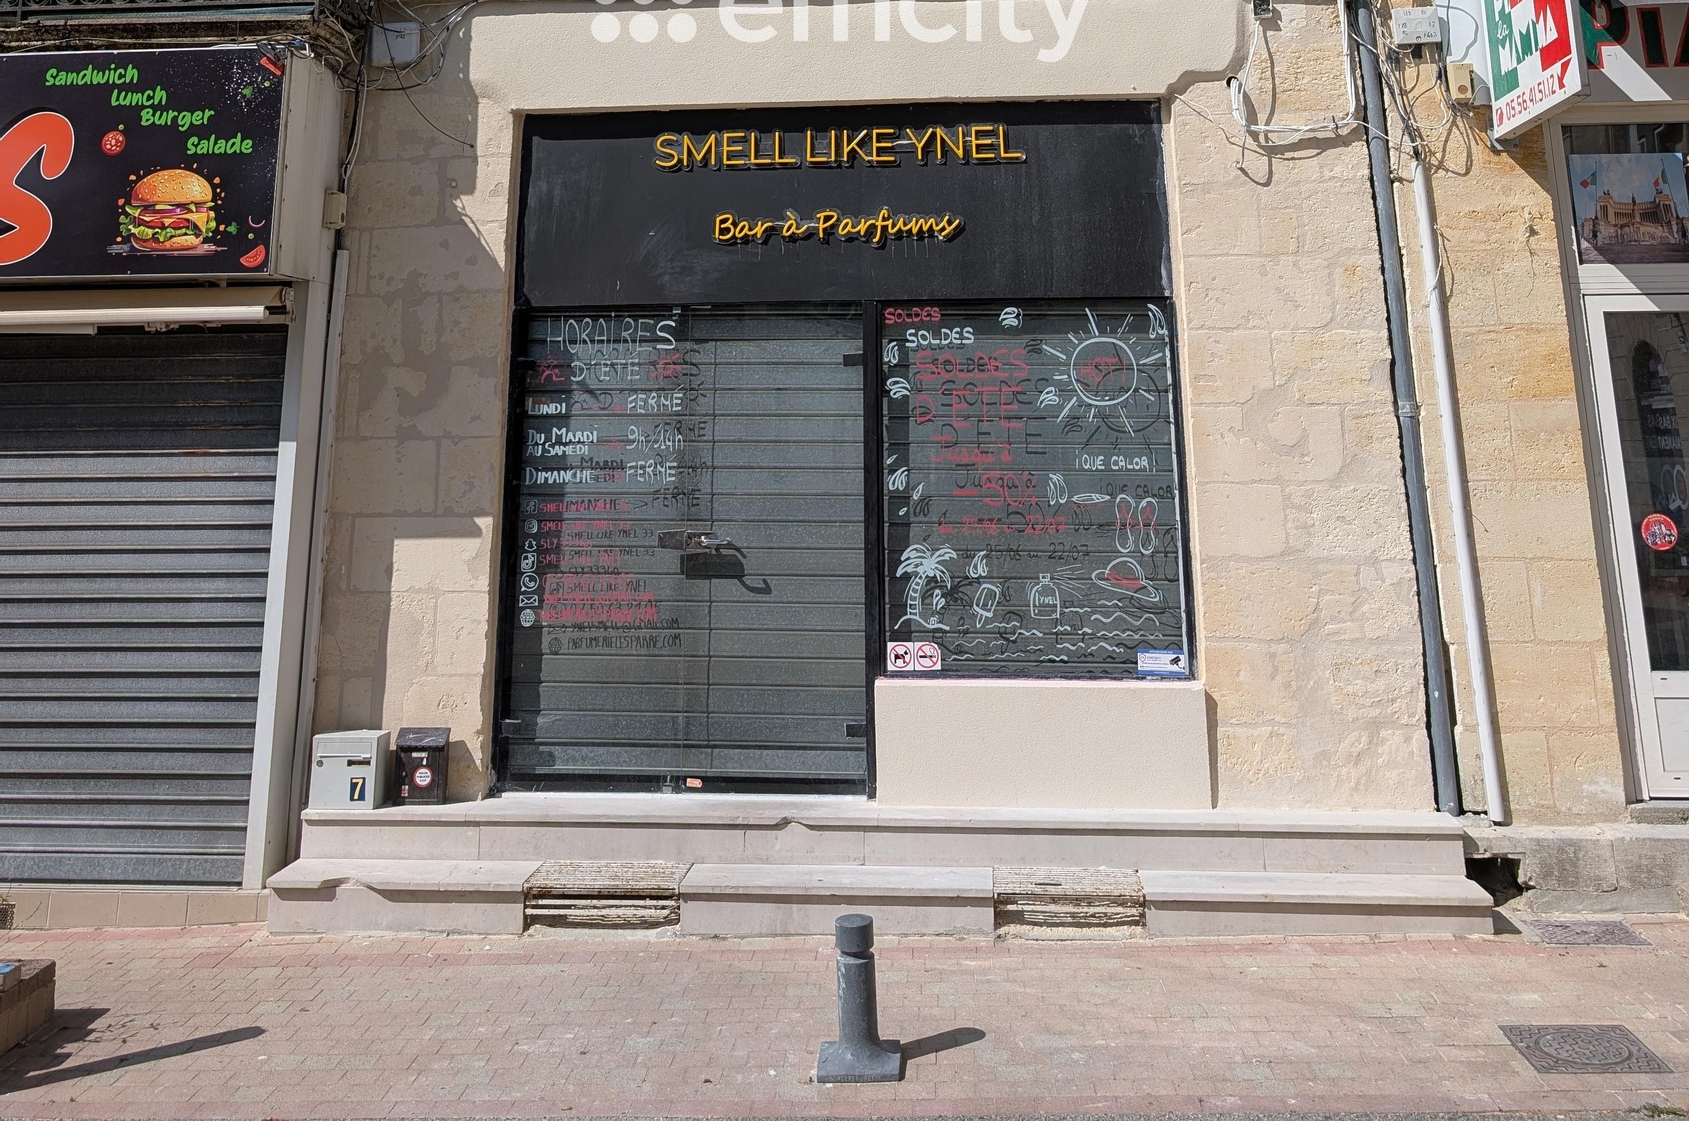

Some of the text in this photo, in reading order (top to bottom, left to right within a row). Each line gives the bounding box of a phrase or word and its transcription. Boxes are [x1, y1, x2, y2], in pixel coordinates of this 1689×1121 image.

[1496, 19, 1510, 40] la
[45, 63, 139, 86] Sandwich
[110, 85, 167, 107] Lunch
[140, 107, 215, 132] Burger
[186, 132, 254, 156] Salade
[654, 124, 1023, 168] SMELL LIKE YNEL
[714, 208, 961, 244] Bar à Parfums
[883, 306, 942, 325] SOLDES
[546, 312, 676, 354] HORAIRES
[905, 326, 975, 348] SOLDES
[626, 384, 685, 415] FERMÉ
[551, 424, 598, 444] MARDI
[526, 441, 589, 457] AU SAMEDI
[525, 454, 678, 485] DIMANCHE FERMÉ
[352, 778, 364, 800] 7
